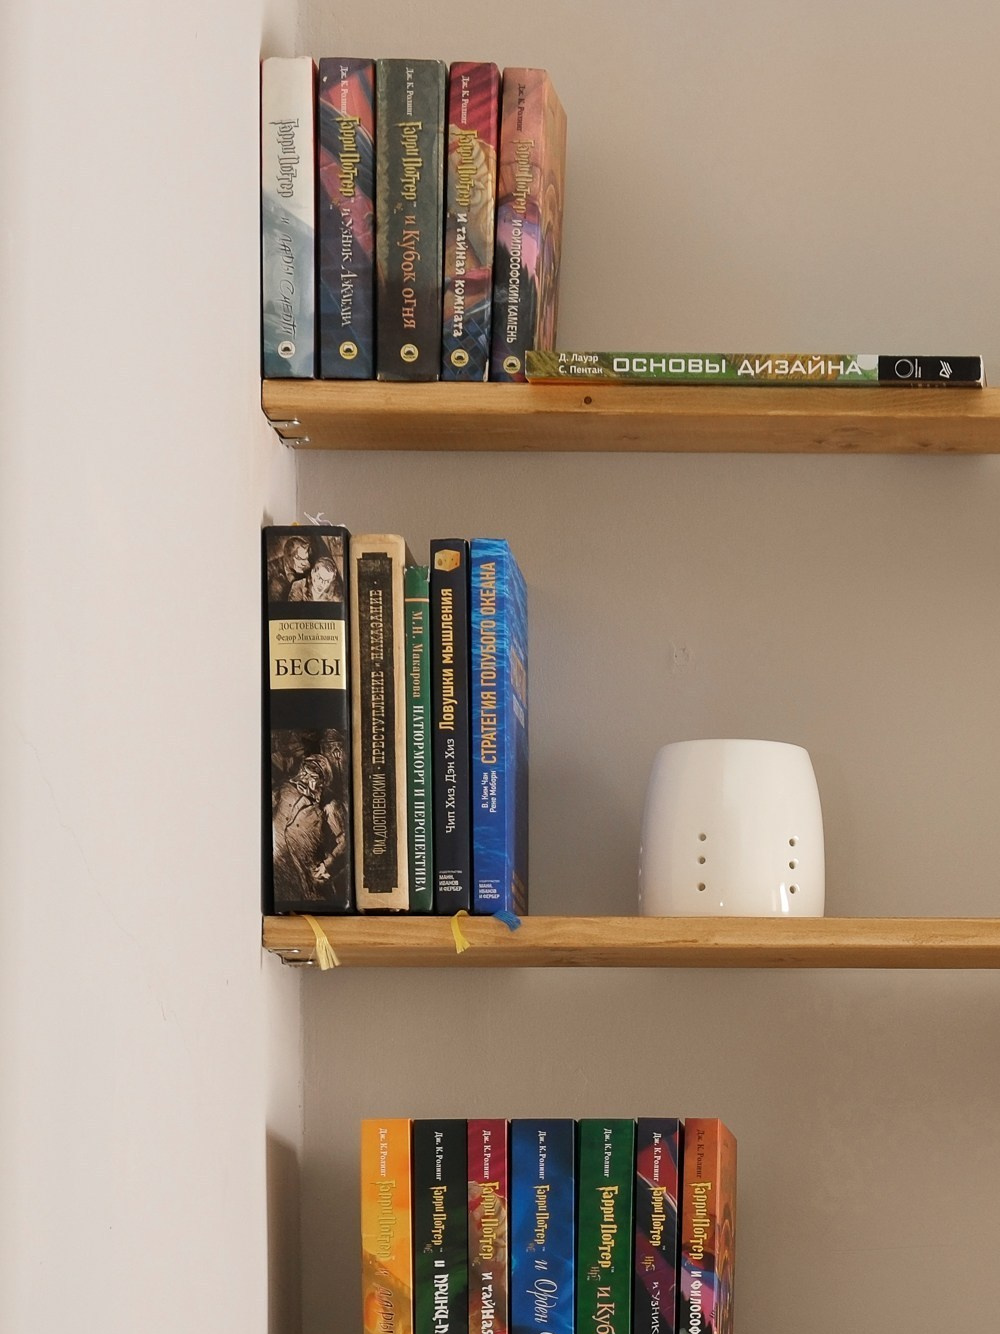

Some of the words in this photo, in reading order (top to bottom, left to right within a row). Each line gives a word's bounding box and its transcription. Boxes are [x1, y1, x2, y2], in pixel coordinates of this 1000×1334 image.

[397, 230, 419, 282] Кубок
[508, 229, 521, 303] ФИЛОСОФСКИЙ
[402, 288, 418, 328] огня
[507, 305, 518, 343] КАМЕНЬ
[559, 354, 568, 362] Д.
[571, 354, 598, 363] Лауэр
[570, 366, 603, 374] Пентак
[613, 357, 725, 374] ОСНОВЫ
[738, 356, 862, 376] ДИЗАЙНА
[480, 563, 495, 615] ОКЕАНА
[276, 633, 297, 642] Федор
[297, 633, 339, 641] Михайлович
[279, 622, 336, 632] ДОСТОЕВСКИЙ
[441, 589, 453, 663] мышления
[275, 658, 341, 676] БЕСЫ
[481, 620, 496, 687] ГОЛУБОГО
[439, 668, 457, 730] Ловушки
[412, 705, 424, 784] НАТЮРМОРТ
[481, 692, 496, 764] СТРАТЕГИЯ
[414, 789, 424, 797] И
[414, 802, 426, 892] ПЕРСПЕКТИВА
[534, 1260, 546, 1270] и
[526, 1279, 558, 1322] Орден
